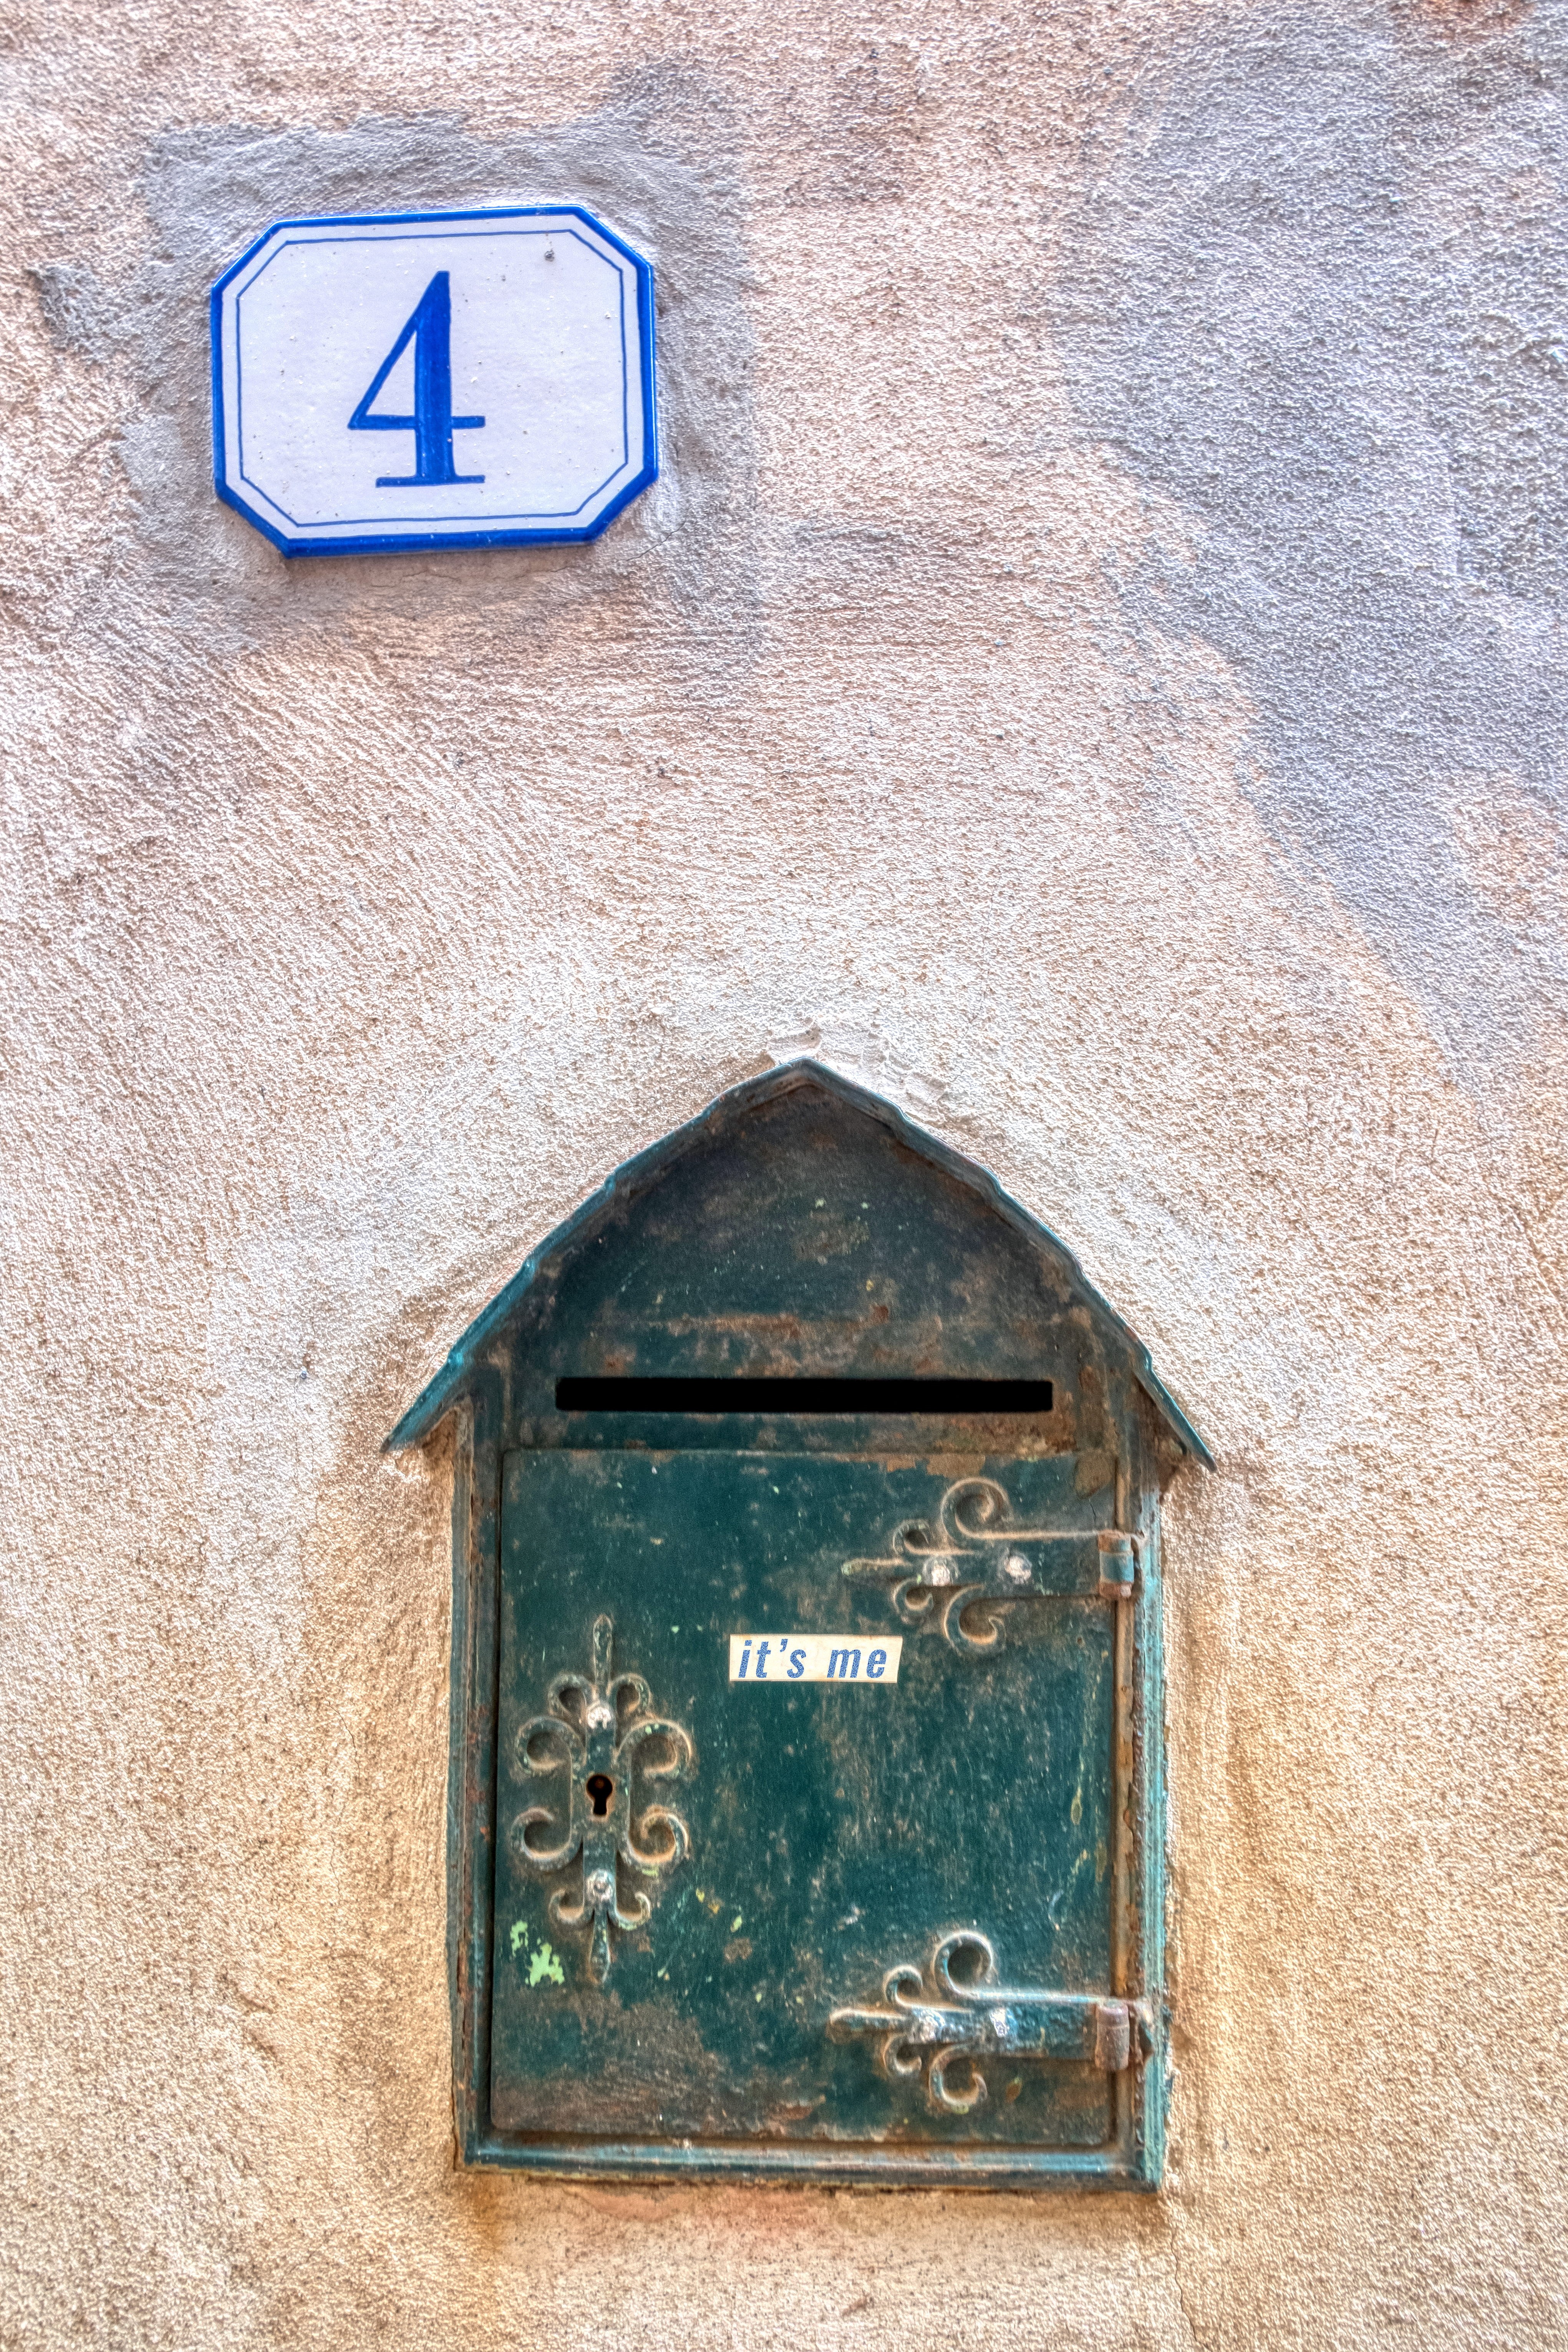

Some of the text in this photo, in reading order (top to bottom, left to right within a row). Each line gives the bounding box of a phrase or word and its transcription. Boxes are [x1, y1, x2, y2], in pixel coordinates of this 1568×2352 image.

[347, 270, 486, 488] 4
[738, 1638, 887, 1679] it's me
